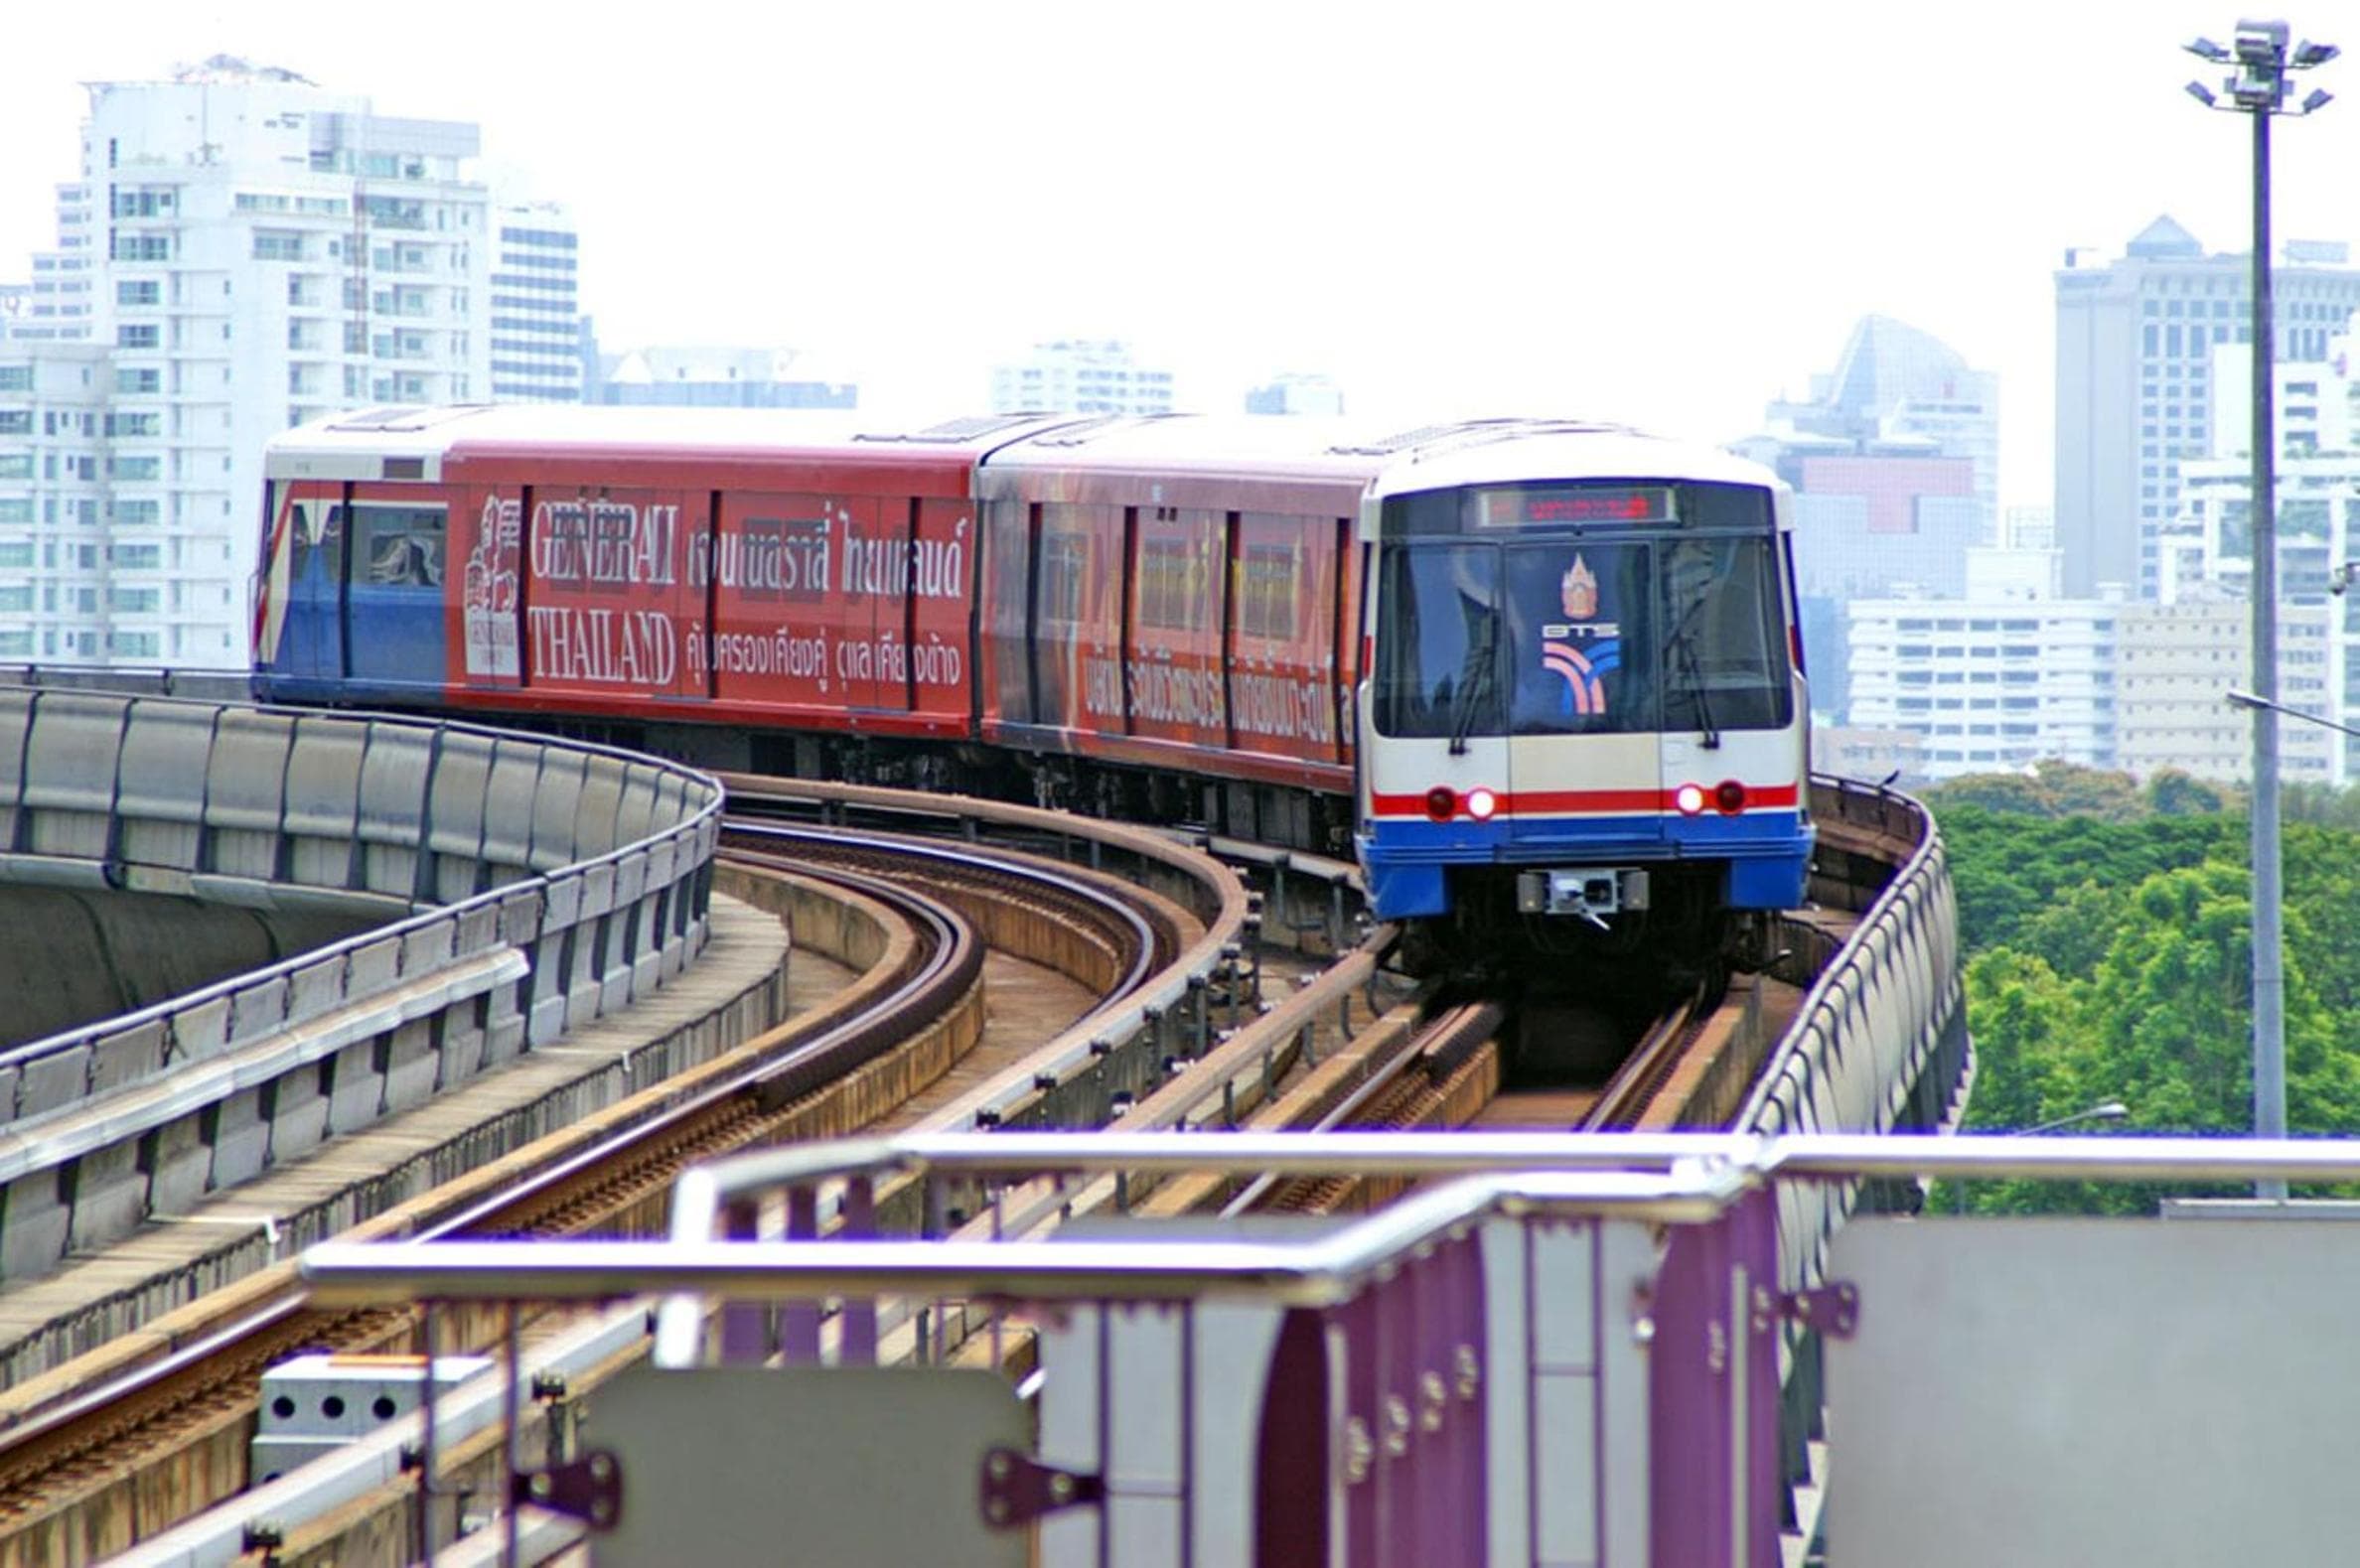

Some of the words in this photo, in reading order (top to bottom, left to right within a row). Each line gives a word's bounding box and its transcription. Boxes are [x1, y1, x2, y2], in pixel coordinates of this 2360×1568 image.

[530, 499, 678, 584] GENERALI
[527, 606, 676, 685] THAILAND
[1543, 623, 1620, 639] BTS
